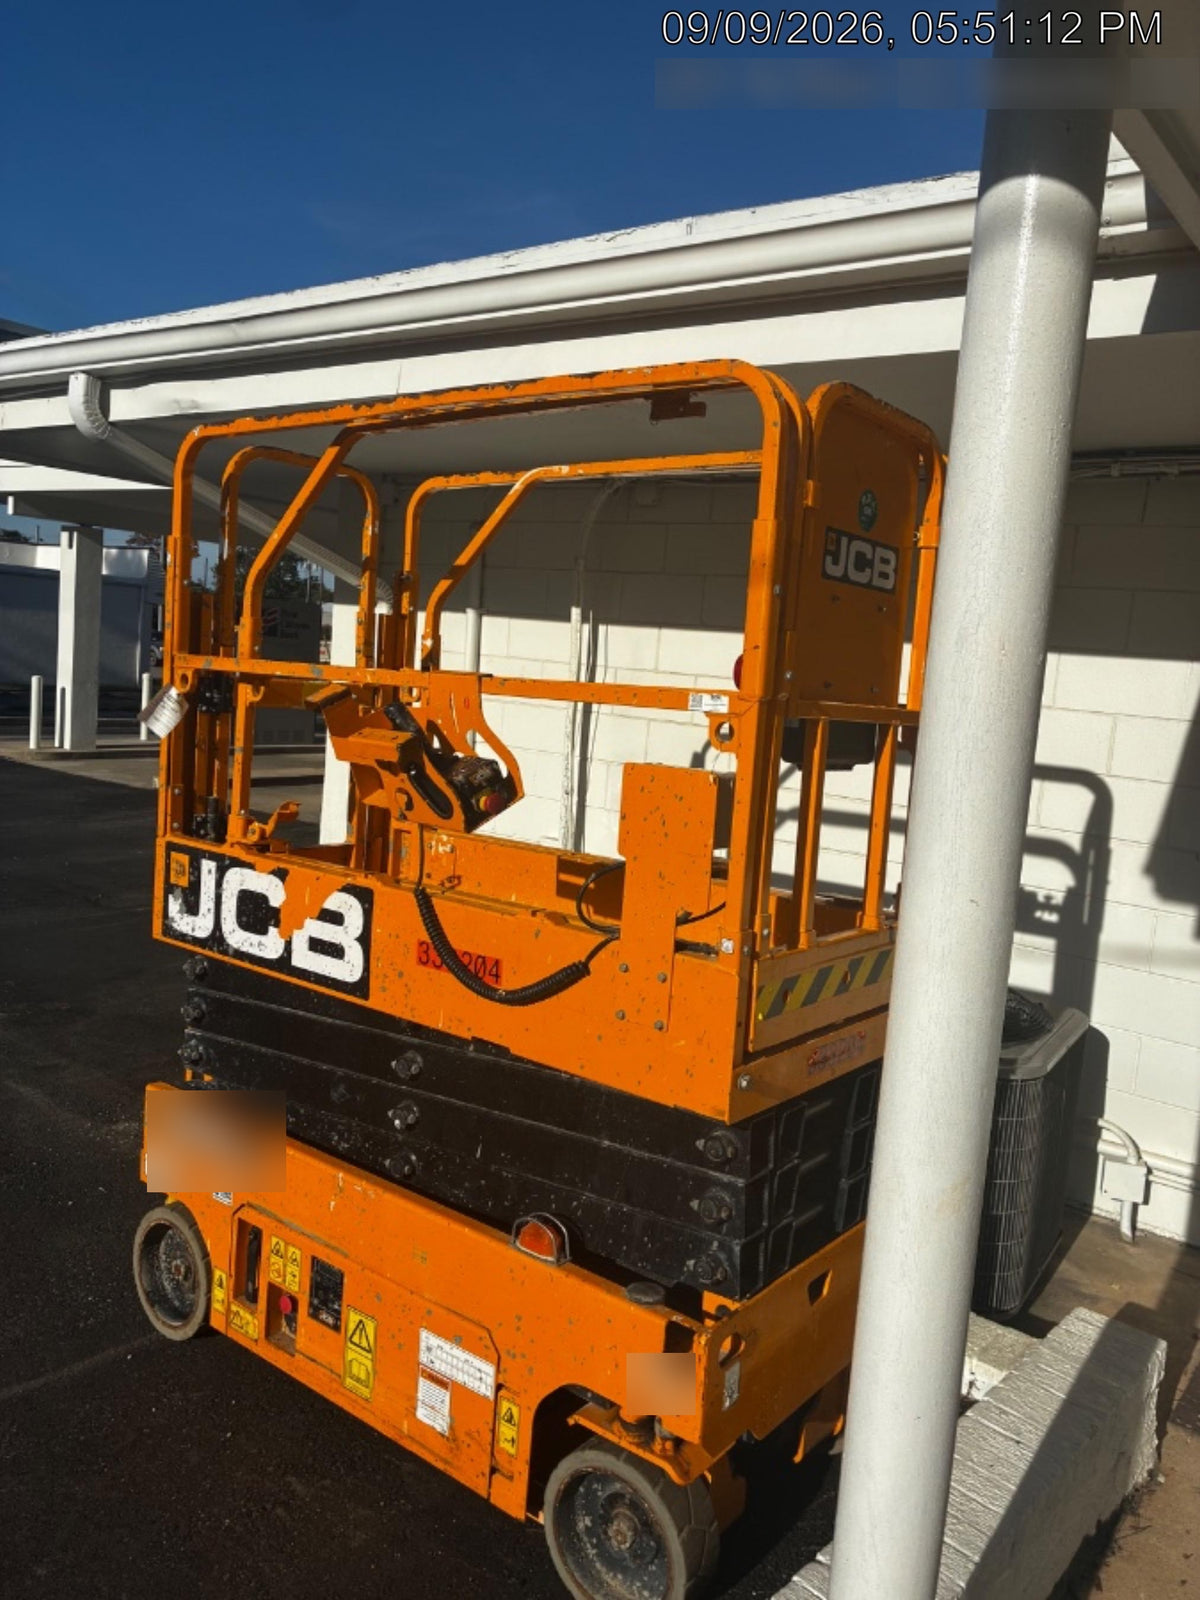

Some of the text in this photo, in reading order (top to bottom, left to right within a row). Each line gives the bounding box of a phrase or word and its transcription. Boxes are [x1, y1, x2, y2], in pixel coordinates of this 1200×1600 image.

[825, 536, 897, 590] JCB
[168, 857, 364, 983] JCB
[417, 940, 502, 984] 3204
